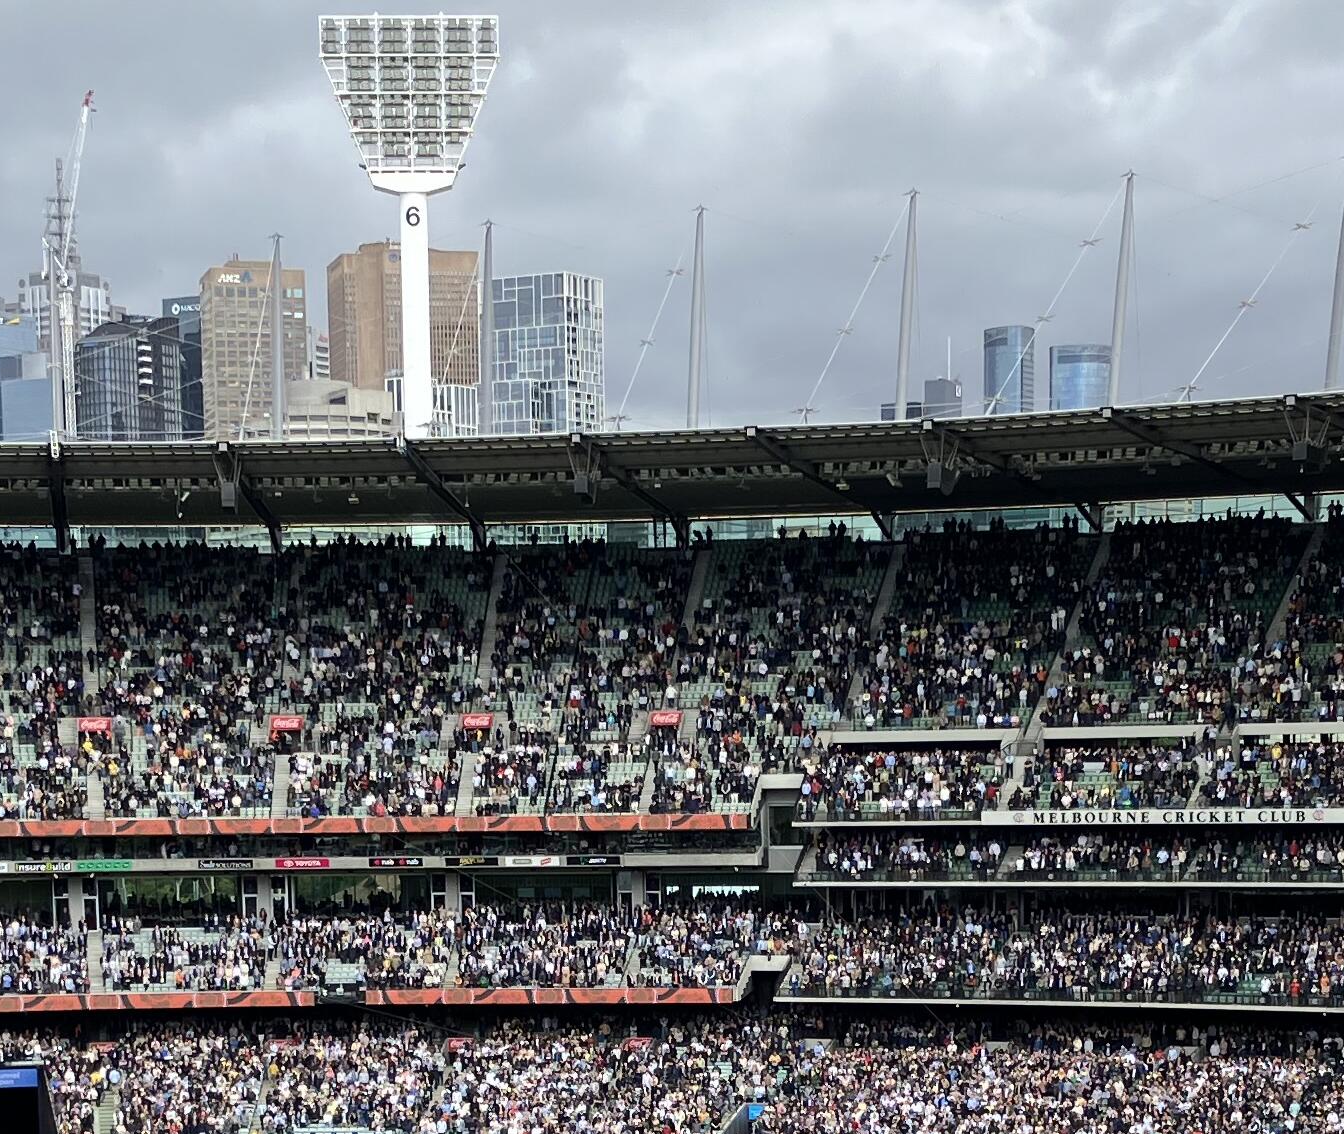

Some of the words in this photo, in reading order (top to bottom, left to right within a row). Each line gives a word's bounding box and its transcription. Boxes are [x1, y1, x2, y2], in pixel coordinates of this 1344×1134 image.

[405, 206, 420, 227] 6
[218, 273, 240, 284] ANZ
[1034, 812, 1150, 824] MELBOURNE
[1162, 811, 1246, 823] CRICKET
[1258, 810, 1306, 822] CLUB
